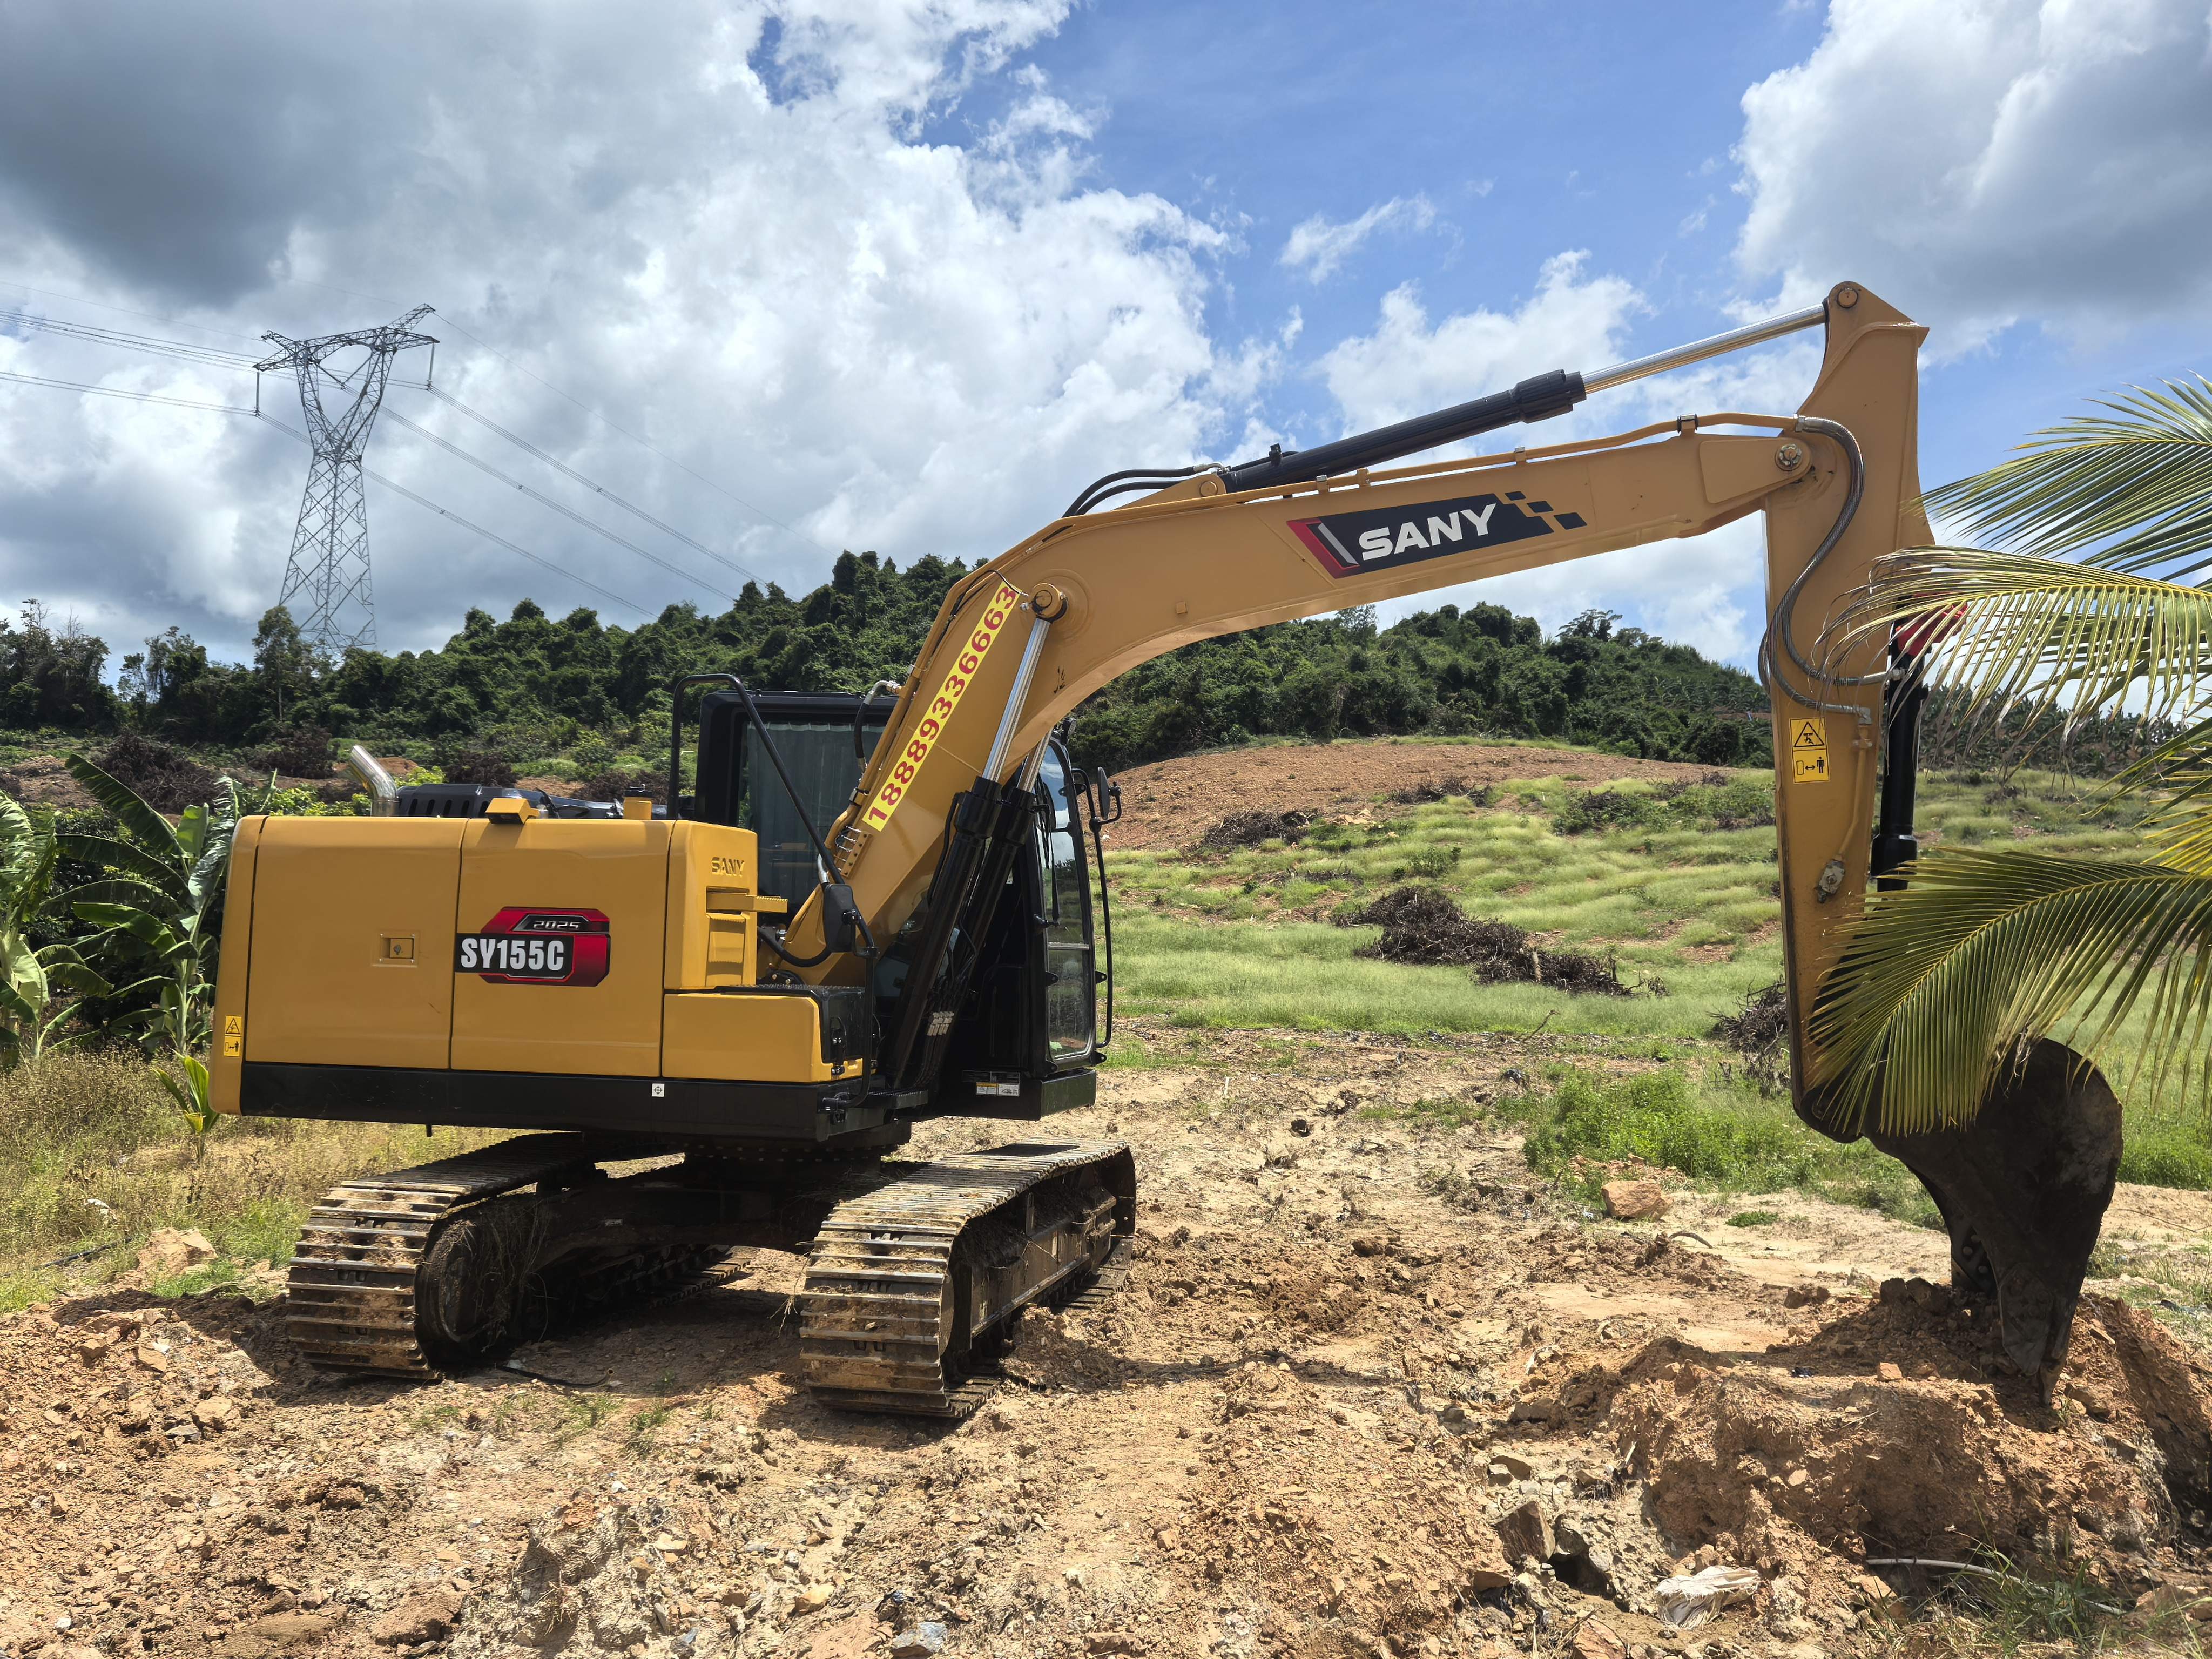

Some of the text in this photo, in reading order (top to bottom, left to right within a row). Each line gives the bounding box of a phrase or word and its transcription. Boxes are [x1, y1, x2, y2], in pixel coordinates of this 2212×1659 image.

[1359, 503, 1496, 561] SANY
[868, 586, 1016, 821] 18889336663
[712, 857, 745, 877] SANY
[533, 920, 581, 929] 2025
[461, 938, 564, 971] SY155C
